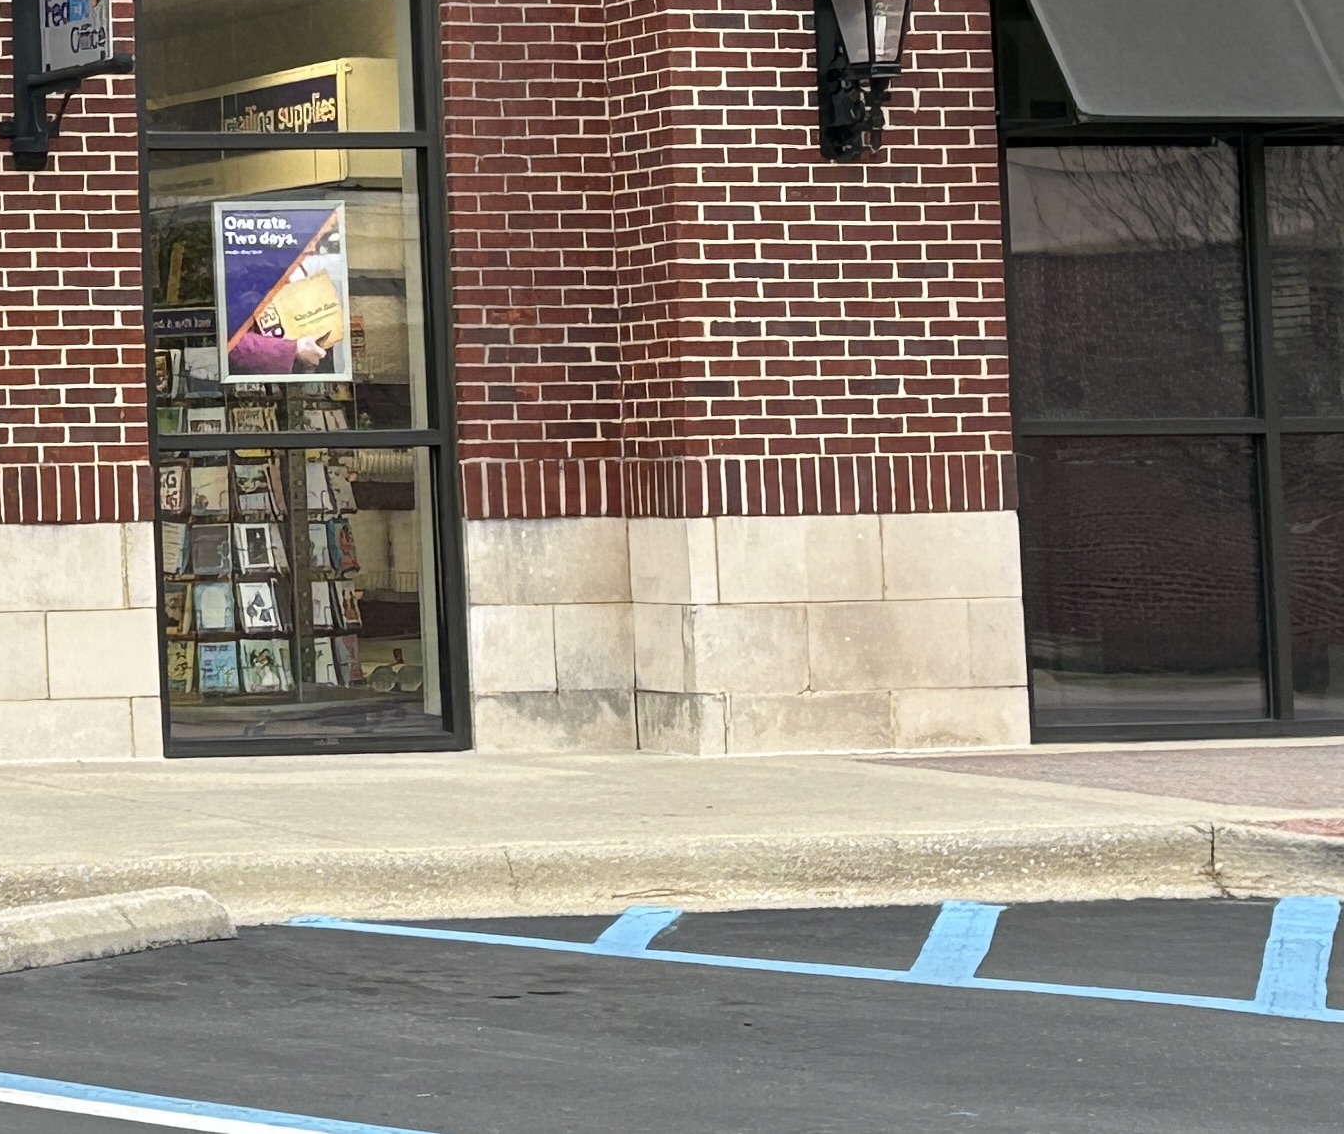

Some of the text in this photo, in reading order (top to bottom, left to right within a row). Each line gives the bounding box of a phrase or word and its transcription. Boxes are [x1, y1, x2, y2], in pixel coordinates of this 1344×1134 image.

[70, 23, 106, 54] Office
[278, 92, 336, 134] supplies
[224, 216, 255, 230] One
[225, 232, 257, 245] Two
